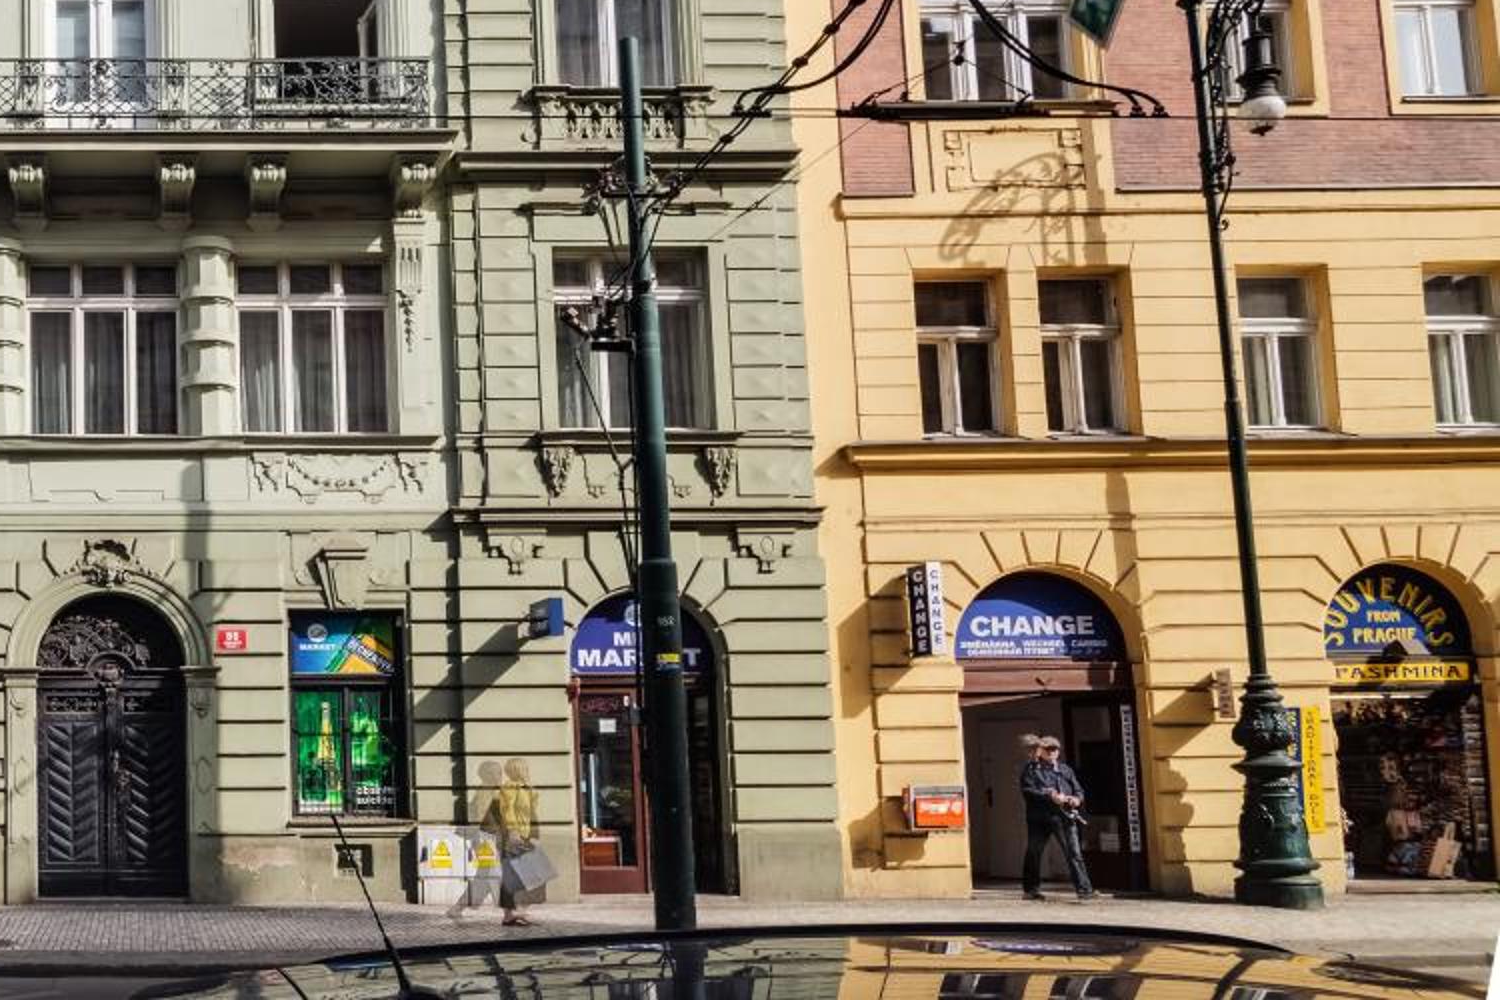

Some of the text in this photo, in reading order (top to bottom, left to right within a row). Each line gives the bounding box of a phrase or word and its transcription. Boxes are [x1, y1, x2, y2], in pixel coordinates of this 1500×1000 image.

[912, 571, 928, 653] CHANGE
[930, 569, 943, 644] CHANGE
[1324, 577, 1455, 647] SOUVENIRS
[1366, 610, 1401, 623] FROM
[970, 615, 1095, 637] CHANGE
[1352, 627, 1417, 644] PRAGUE
[578, 648, 701, 667] MART
[1334, 664, 1463, 679] PASHMINA
